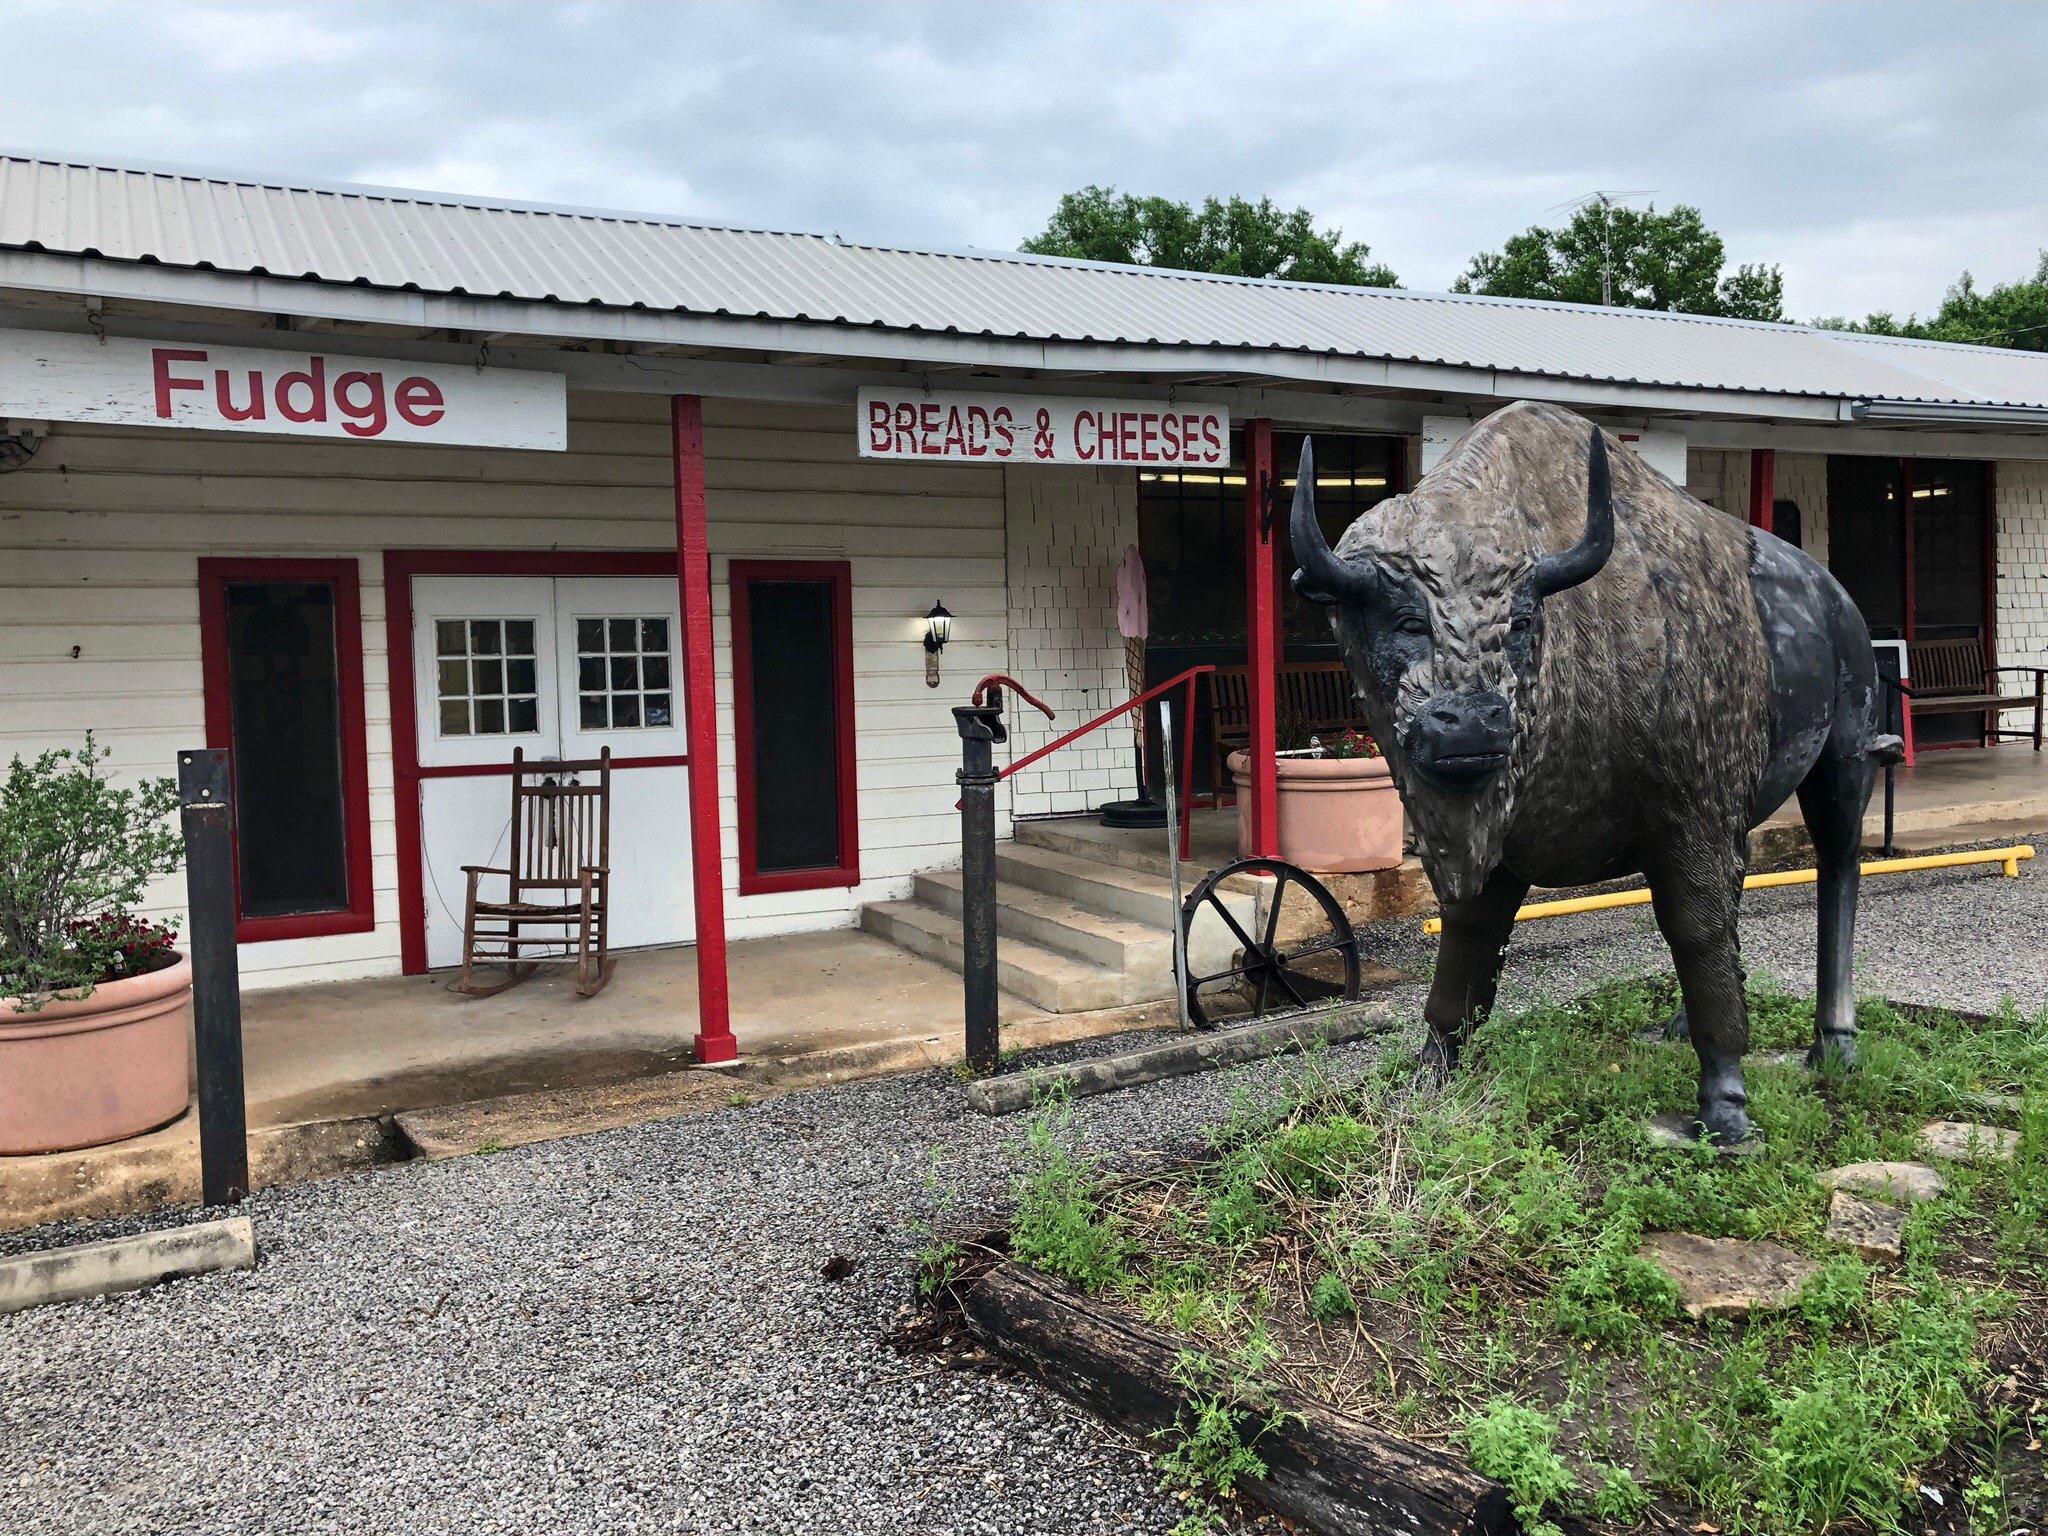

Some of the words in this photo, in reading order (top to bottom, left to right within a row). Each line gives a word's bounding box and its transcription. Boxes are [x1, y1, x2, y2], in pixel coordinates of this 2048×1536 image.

[153, 348, 446, 436] Fudge
[869, 401, 1014, 457] BREADS
[1034, 407, 1055, 460] &
[1073, 409, 1221, 463] CHEESES
